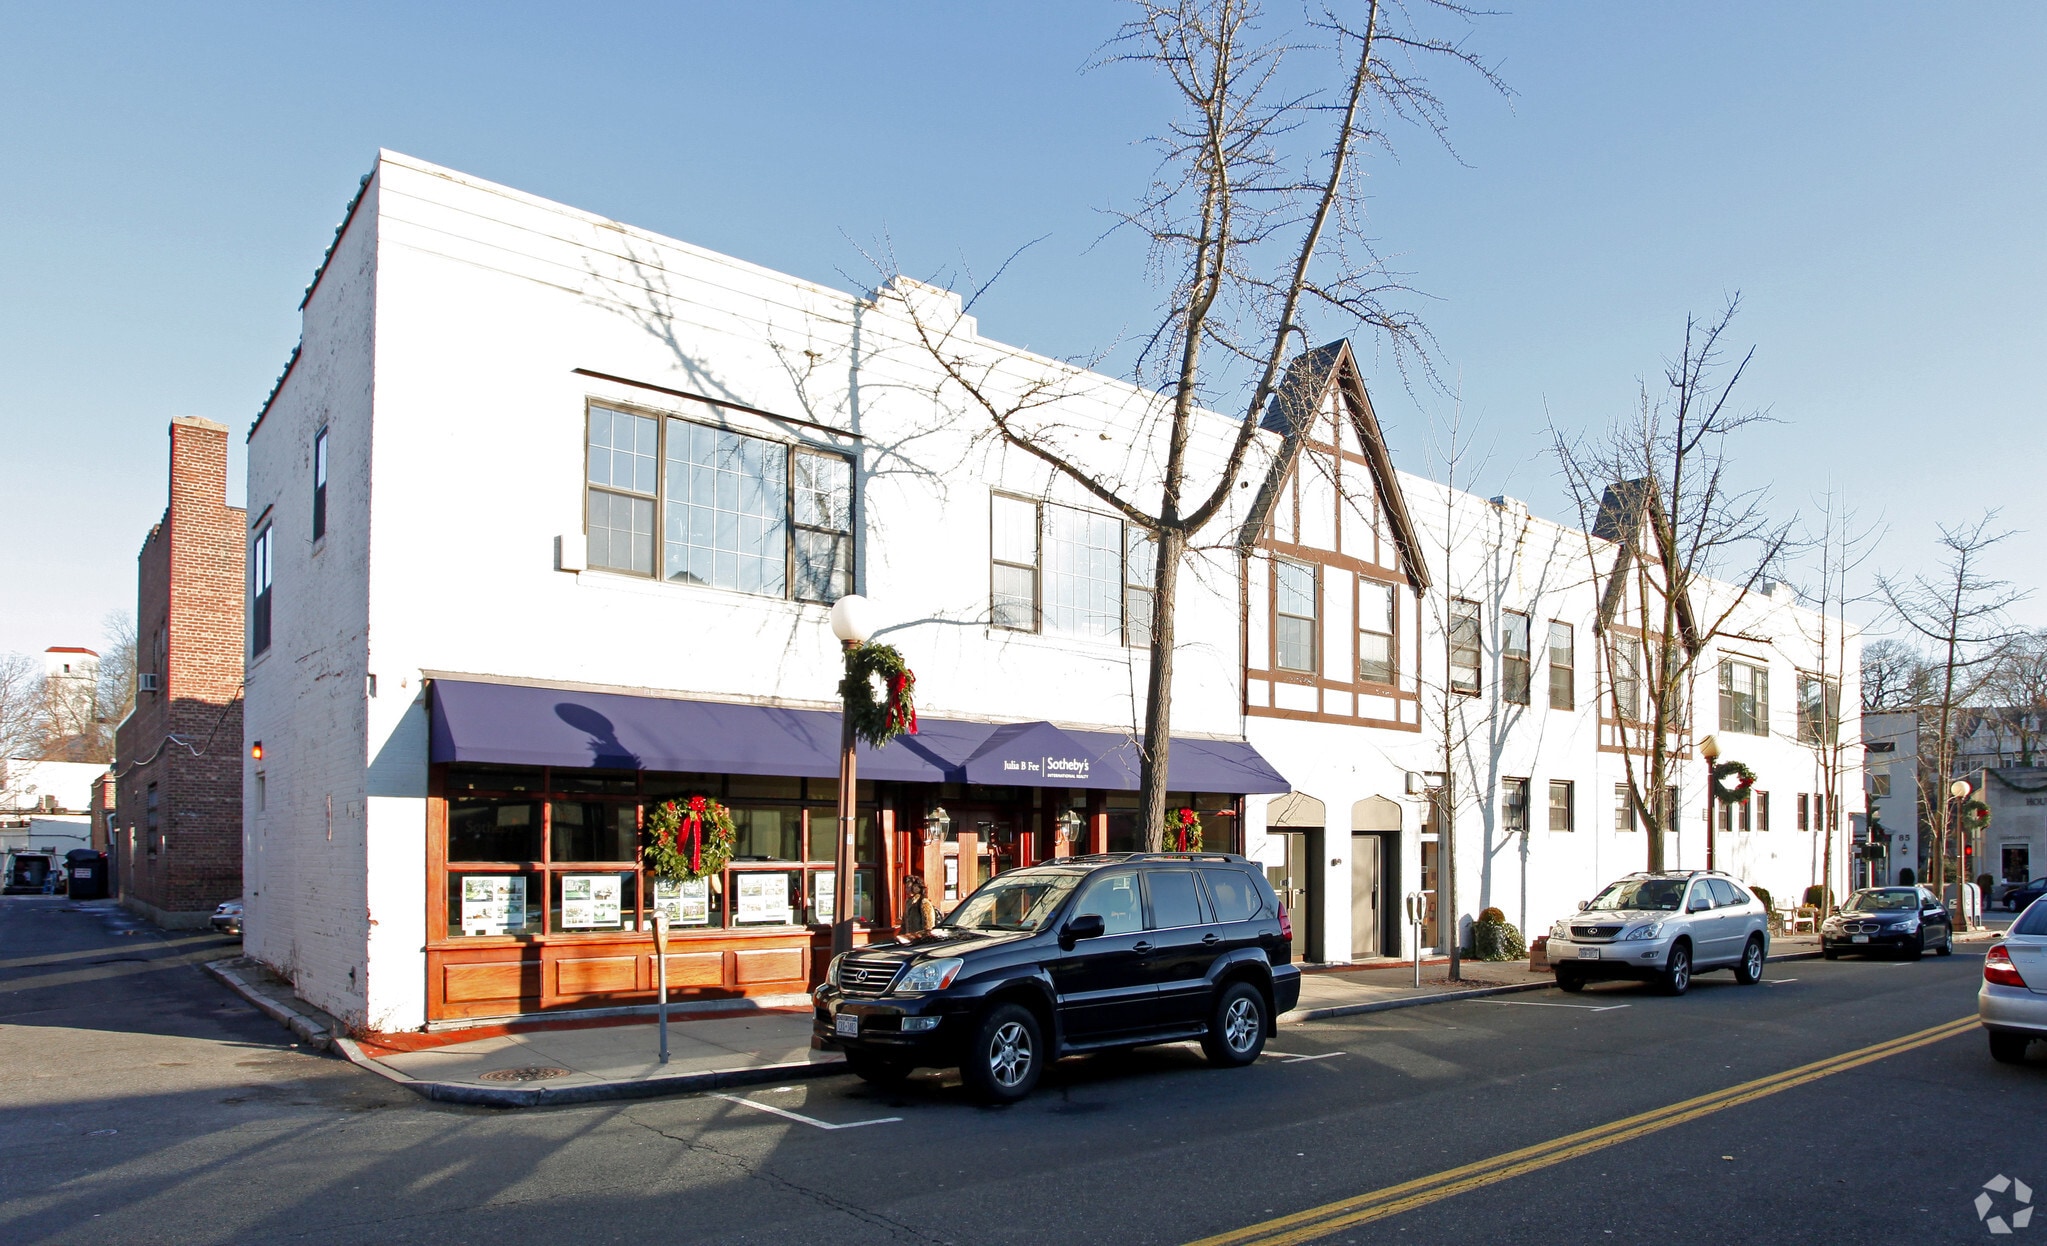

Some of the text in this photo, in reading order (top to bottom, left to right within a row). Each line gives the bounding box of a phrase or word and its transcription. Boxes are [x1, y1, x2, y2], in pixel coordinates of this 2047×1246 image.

[1004, 760, 1040, 771] Julia B Fee
[1047, 757, 1089, 774] Sotheby's
[1898, 834, 1911, 842] 85
